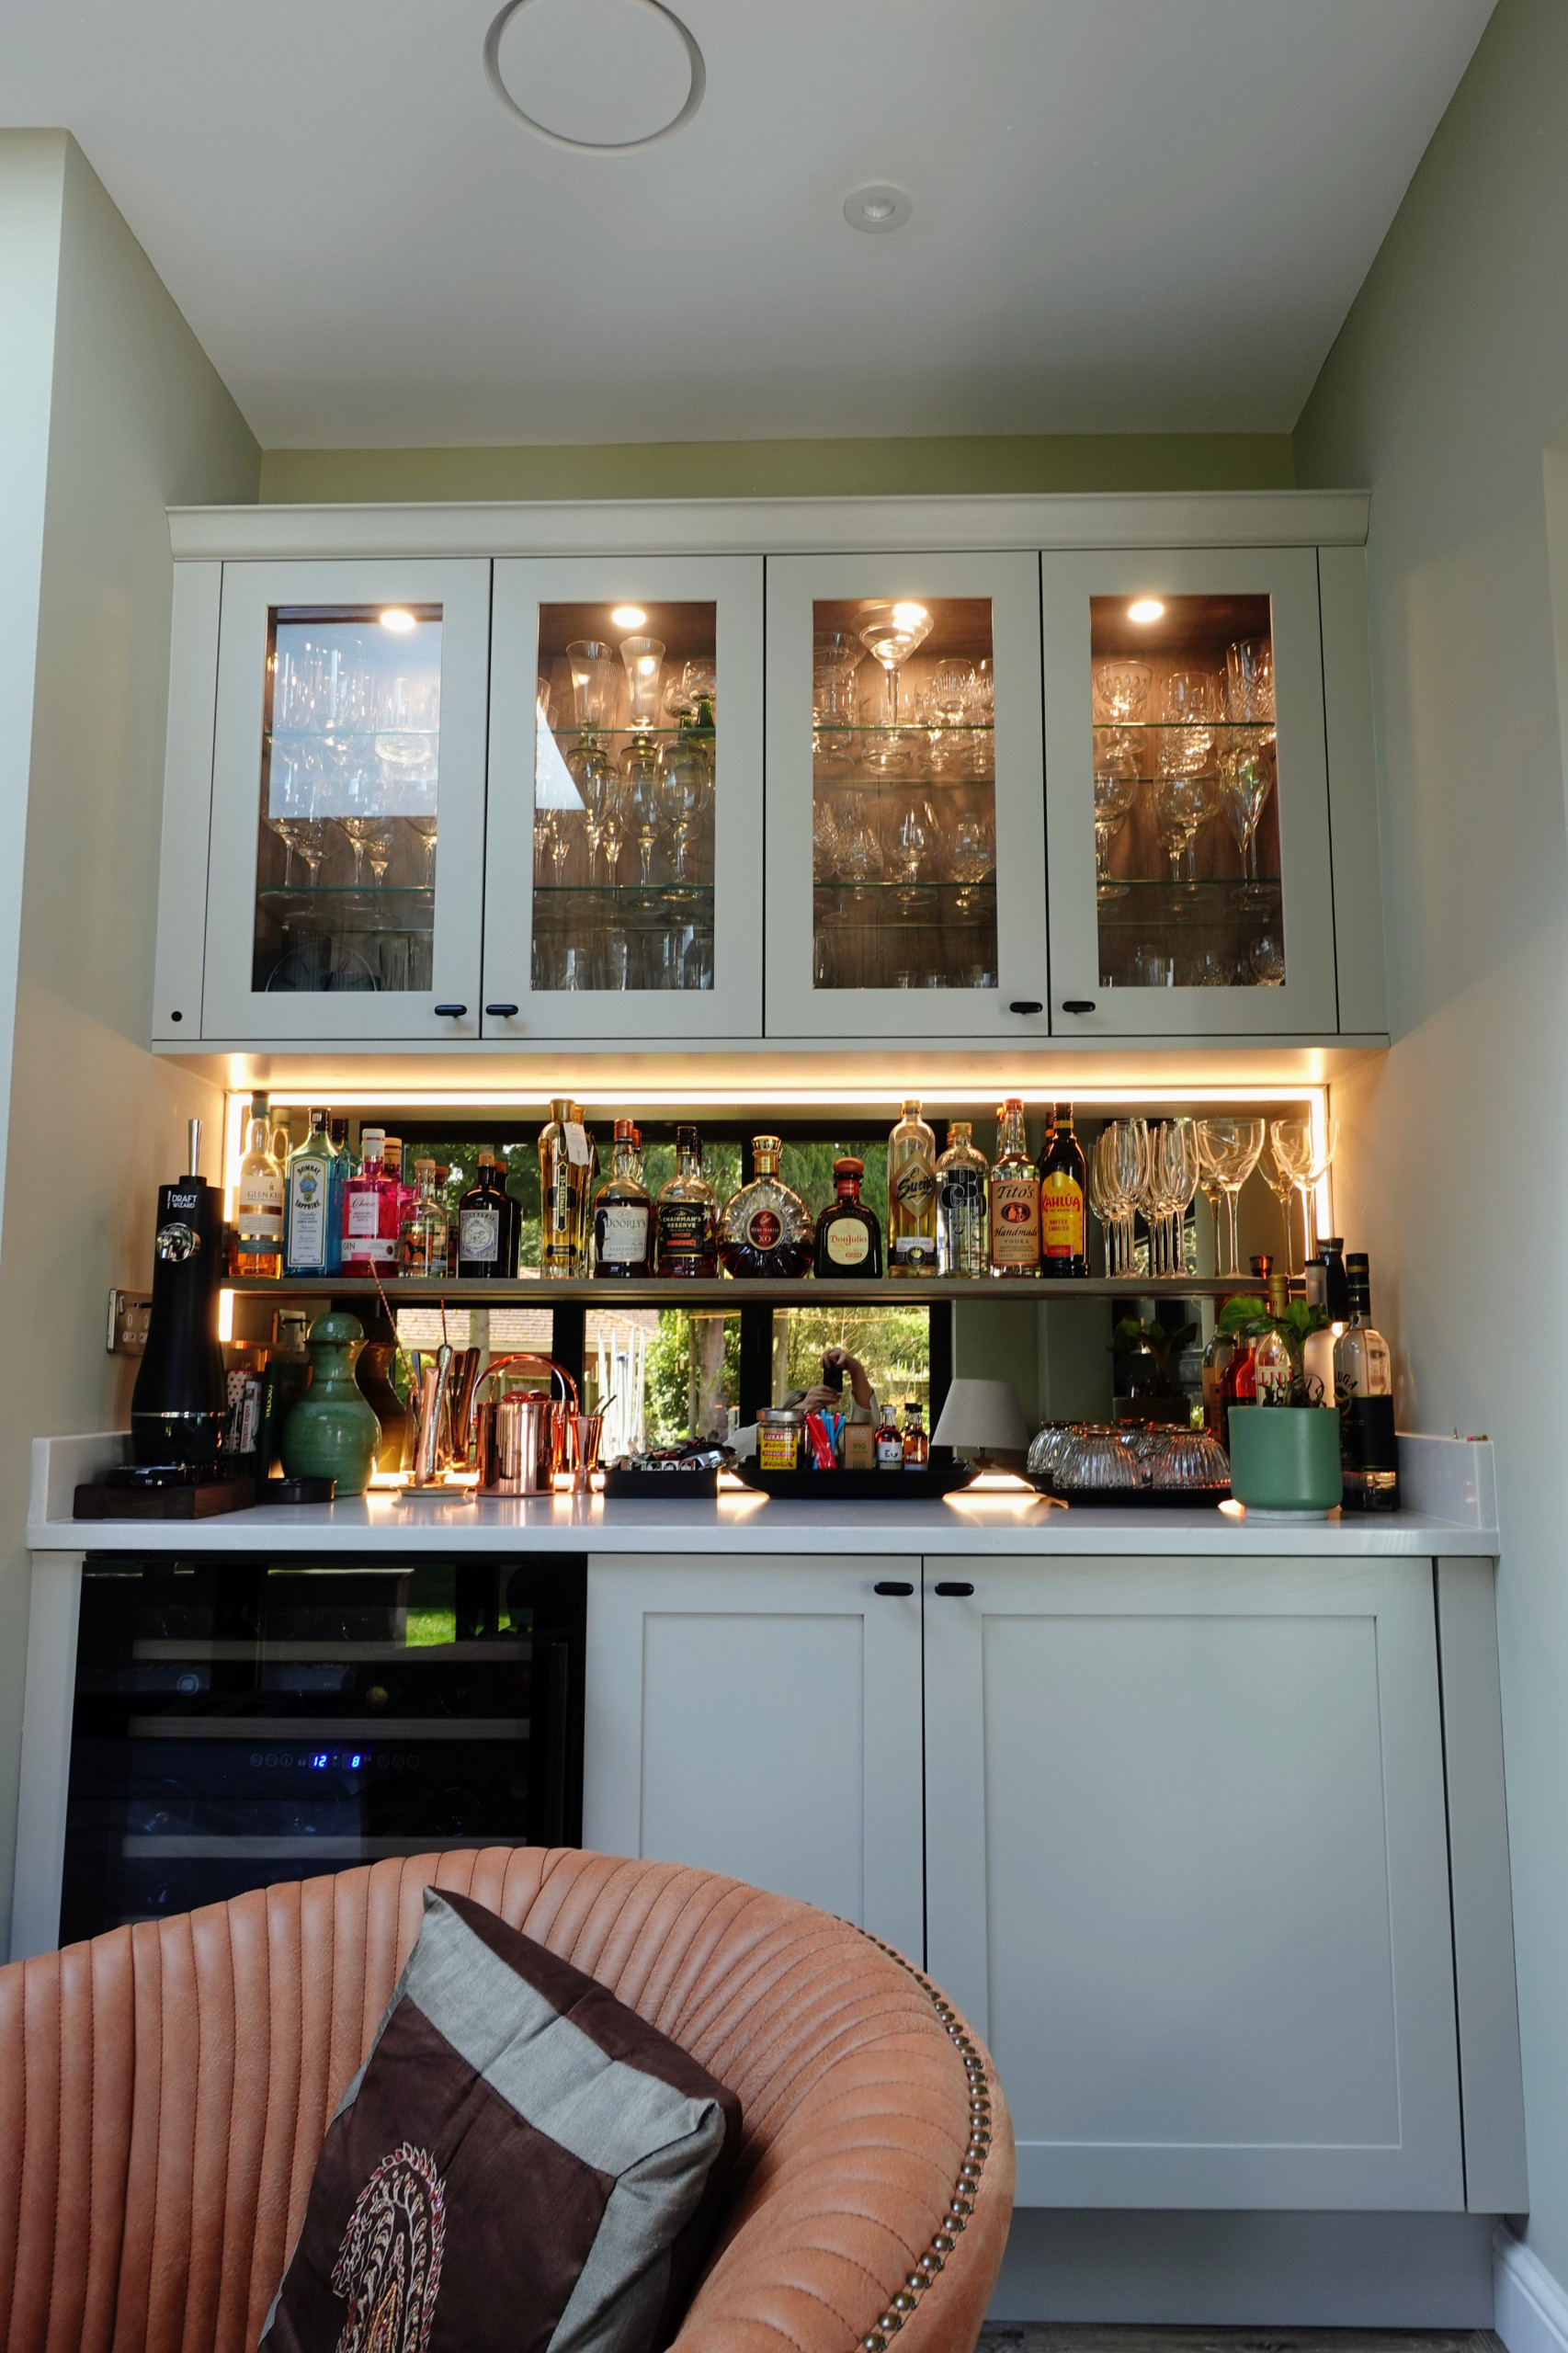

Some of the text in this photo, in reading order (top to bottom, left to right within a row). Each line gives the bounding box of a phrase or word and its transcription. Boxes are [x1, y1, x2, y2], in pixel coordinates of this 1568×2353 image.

[297, 1165, 321, 1176] BOMBAY
[247, 1190, 268, 1199] GLEN
[997, 1185, 1034, 1199] Tito's
[172, 1195, 198, 1203] DRAFT
[295, 1199, 323, 1210] SAPPHIRE
[351, 1196, 375, 1209] Chase
[1041, 1193, 1081, 1212] KAHLÚA
[607, 1219, 645, 1229] DOORLY'S
[313, 1756, 361, 1768] 12 8
